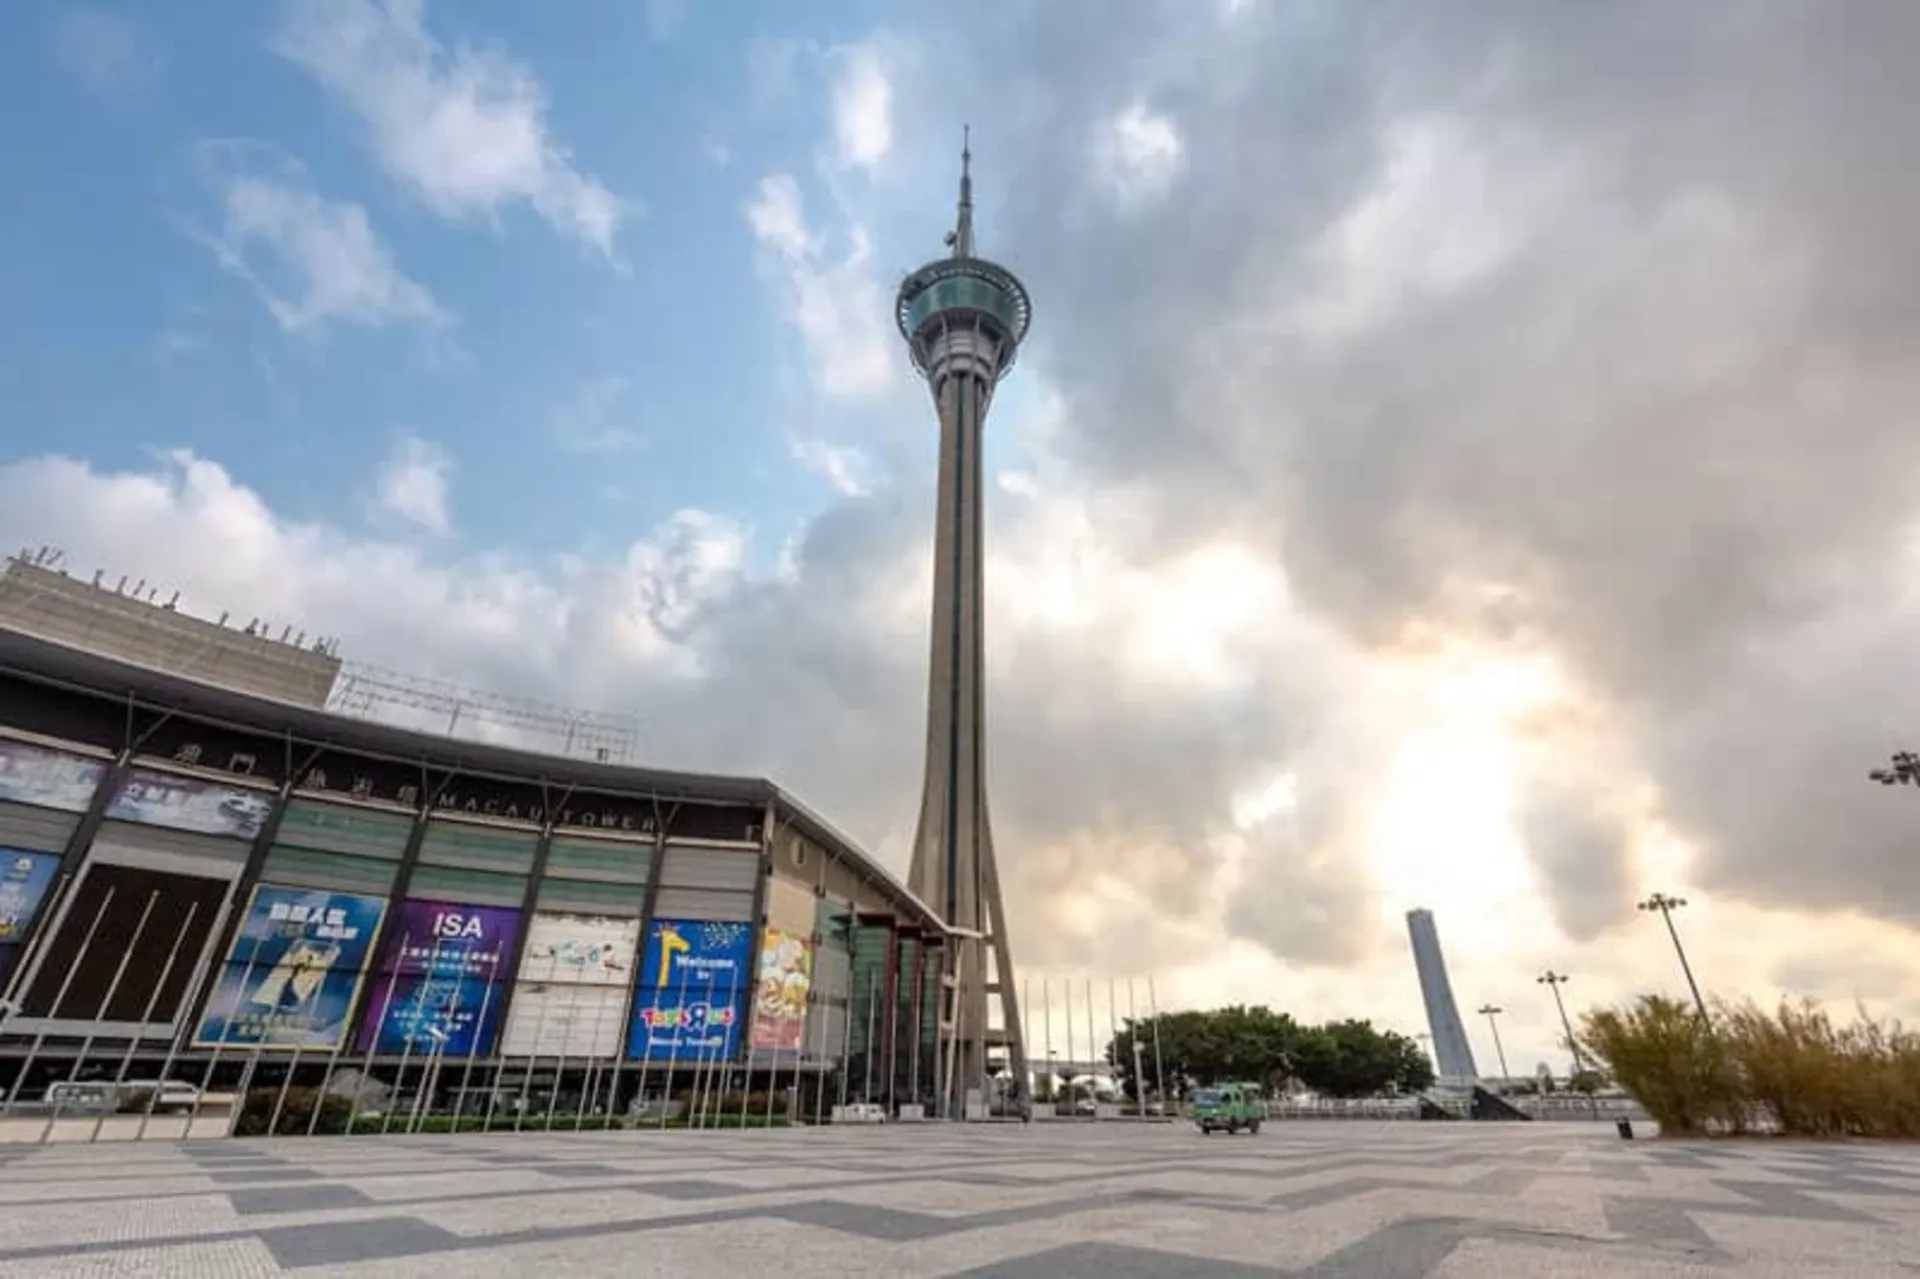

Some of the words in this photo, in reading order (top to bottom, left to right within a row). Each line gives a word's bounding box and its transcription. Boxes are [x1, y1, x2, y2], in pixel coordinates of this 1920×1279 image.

[438, 793, 543, 821] MACAU
[562, 808, 656, 831] TOWER
[432, 912, 483, 938] ISA
[676, 955, 734, 968] Welcome
